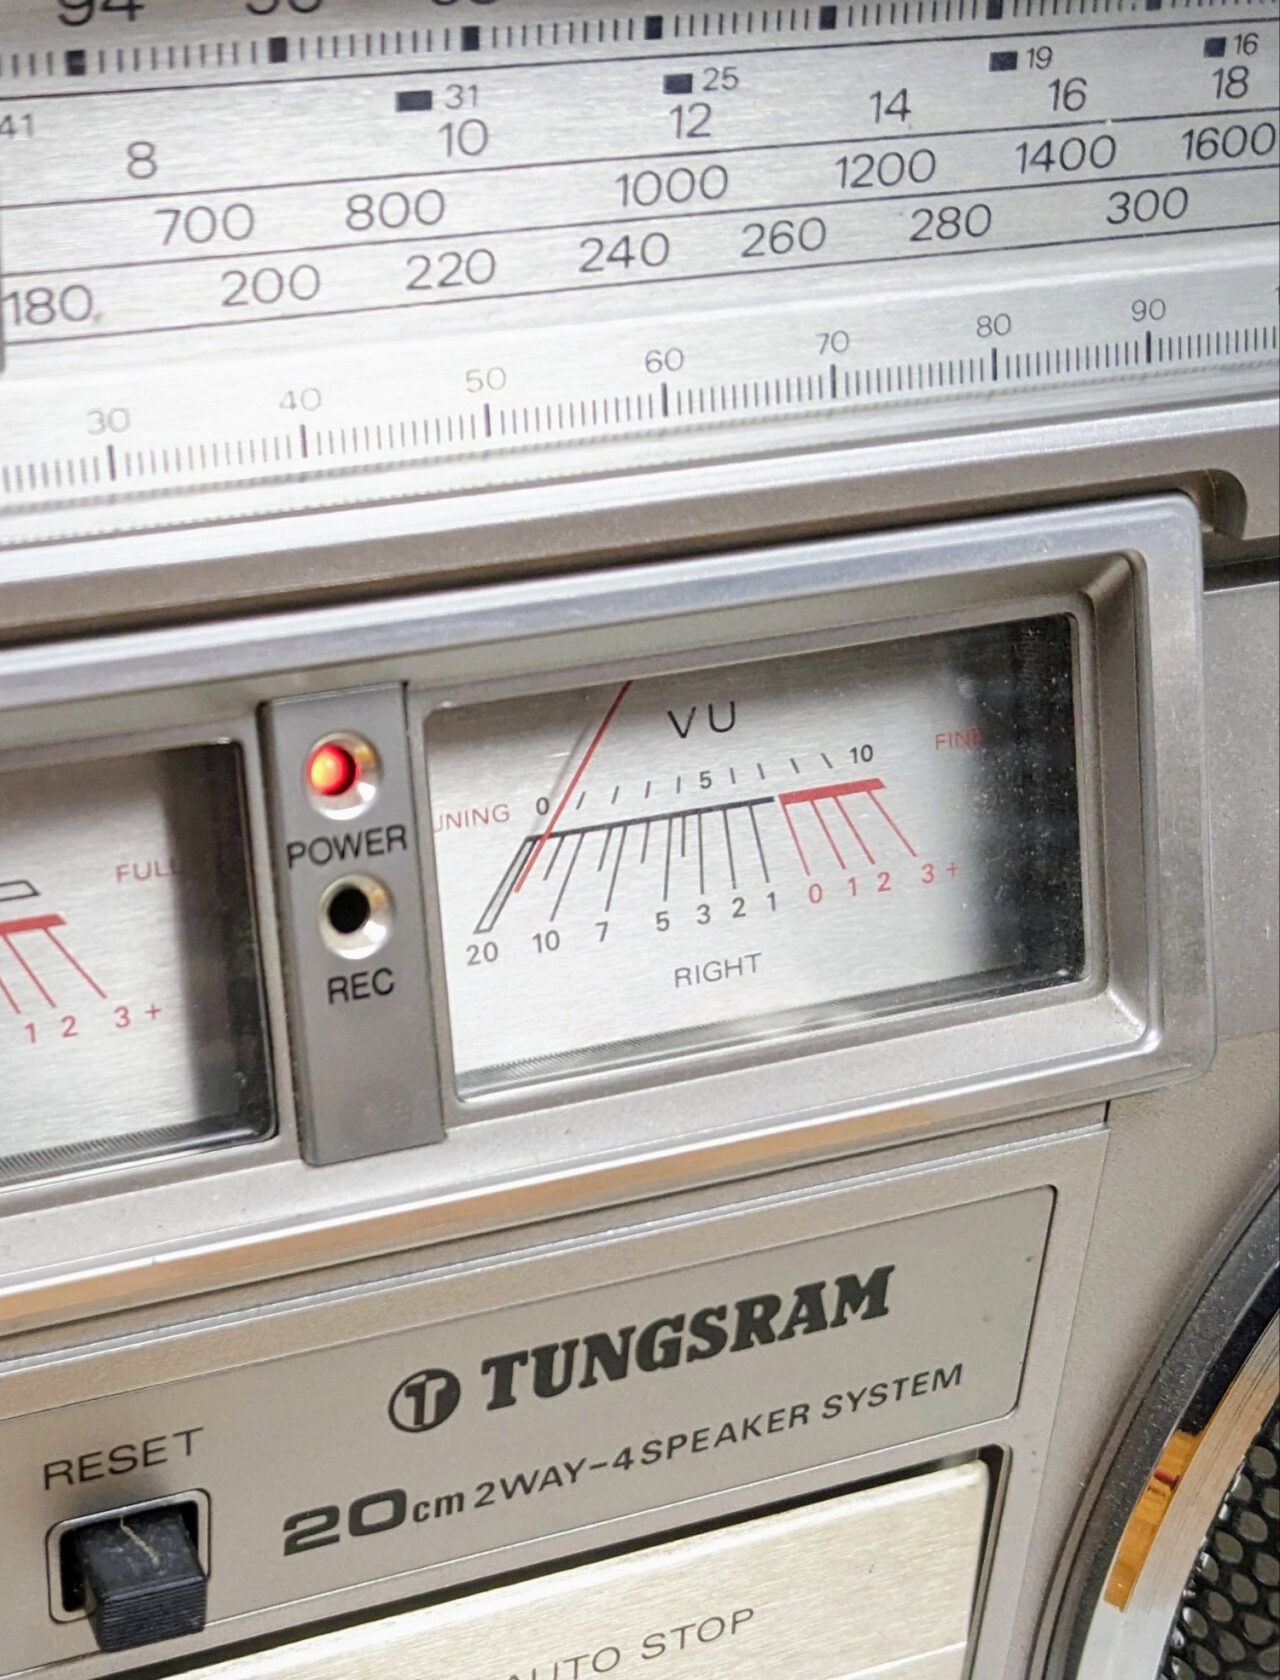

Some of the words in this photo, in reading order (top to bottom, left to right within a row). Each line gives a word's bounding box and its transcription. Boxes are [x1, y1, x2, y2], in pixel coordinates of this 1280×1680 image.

[444, 84, 478, 110] 31
[701, 67, 739, 91] 25
[1026, 46, 1052, 69] 19
[1234, 33, 1258, 55] 16
[127, 141, 157, 179] 8
[438, 119, 488, 157] 10
[669, 103, 711, 139] 12
[869, 88, 911, 123] 14
[1048, 78, 1087, 111] 16
[1211, 66, 1249, 99] 18
[156, 203, 254, 246] 700
[346, 189, 445, 231] 800
[615, 165, 728, 207] 1000
[835, 149, 936, 189] 1200
[1015, 135, 1116, 174] 1400
[1181, 122, 1276, 161] 1600
[3, 284, 93, 326] 180
[221, 265, 320, 307] 200
[406, 249, 496, 291] 220
[578, 232, 670, 273] 240
[741, 217, 828, 258] 260
[910, 204, 992, 242] 280
[1106, 187, 1189, 224] 300
[85, 407, 132, 436] 30
[278, 388, 322, 412] 40
[465, 367, 507, 394] 50
[645, 347, 685, 374] 60
[817, 330, 850, 354] 70
[976, 313, 1013, 338] 80
[1130, 298, 1166, 322] 90
[535, 796, 550, 816] 0
[699, 771, 712, 789] 5
[849, 744, 874, 765] 10
[286, 823, 408, 870] POWER
[433, 803, 510, 834] UNING
[466, 941, 499, 966] 20
[532, 930, 560, 954] 10
[595, 921, 609, 943] 7
[656, 911, 670, 932] 5
[696, 904, 711, 925] 3
[732, 897, 747, 918] 2
[766, 892, 776, 911] 1
[808, 883, 823, 904] 0
[848, 877, 858, 896] 1
[877, 871, 891, 893] 2
[922, 863, 936, 884] 3
[327, 967, 395, 1004] REC
[674, 952, 762, 988] RIGHT
[25, 1022, 38, 1044] 1
[61, 1015, 78, 1037] 2
[114, 1005, 131, 1029] 3
[480, 1264, 896, 1411] TUNGSRAM
[821, 1363, 963, 1420] SYSTEM
[43, 1427, 204, 1490] RESET
[507, 1646, 620, 1680] UTO
[641, 1608, 754, 1660] STOP
